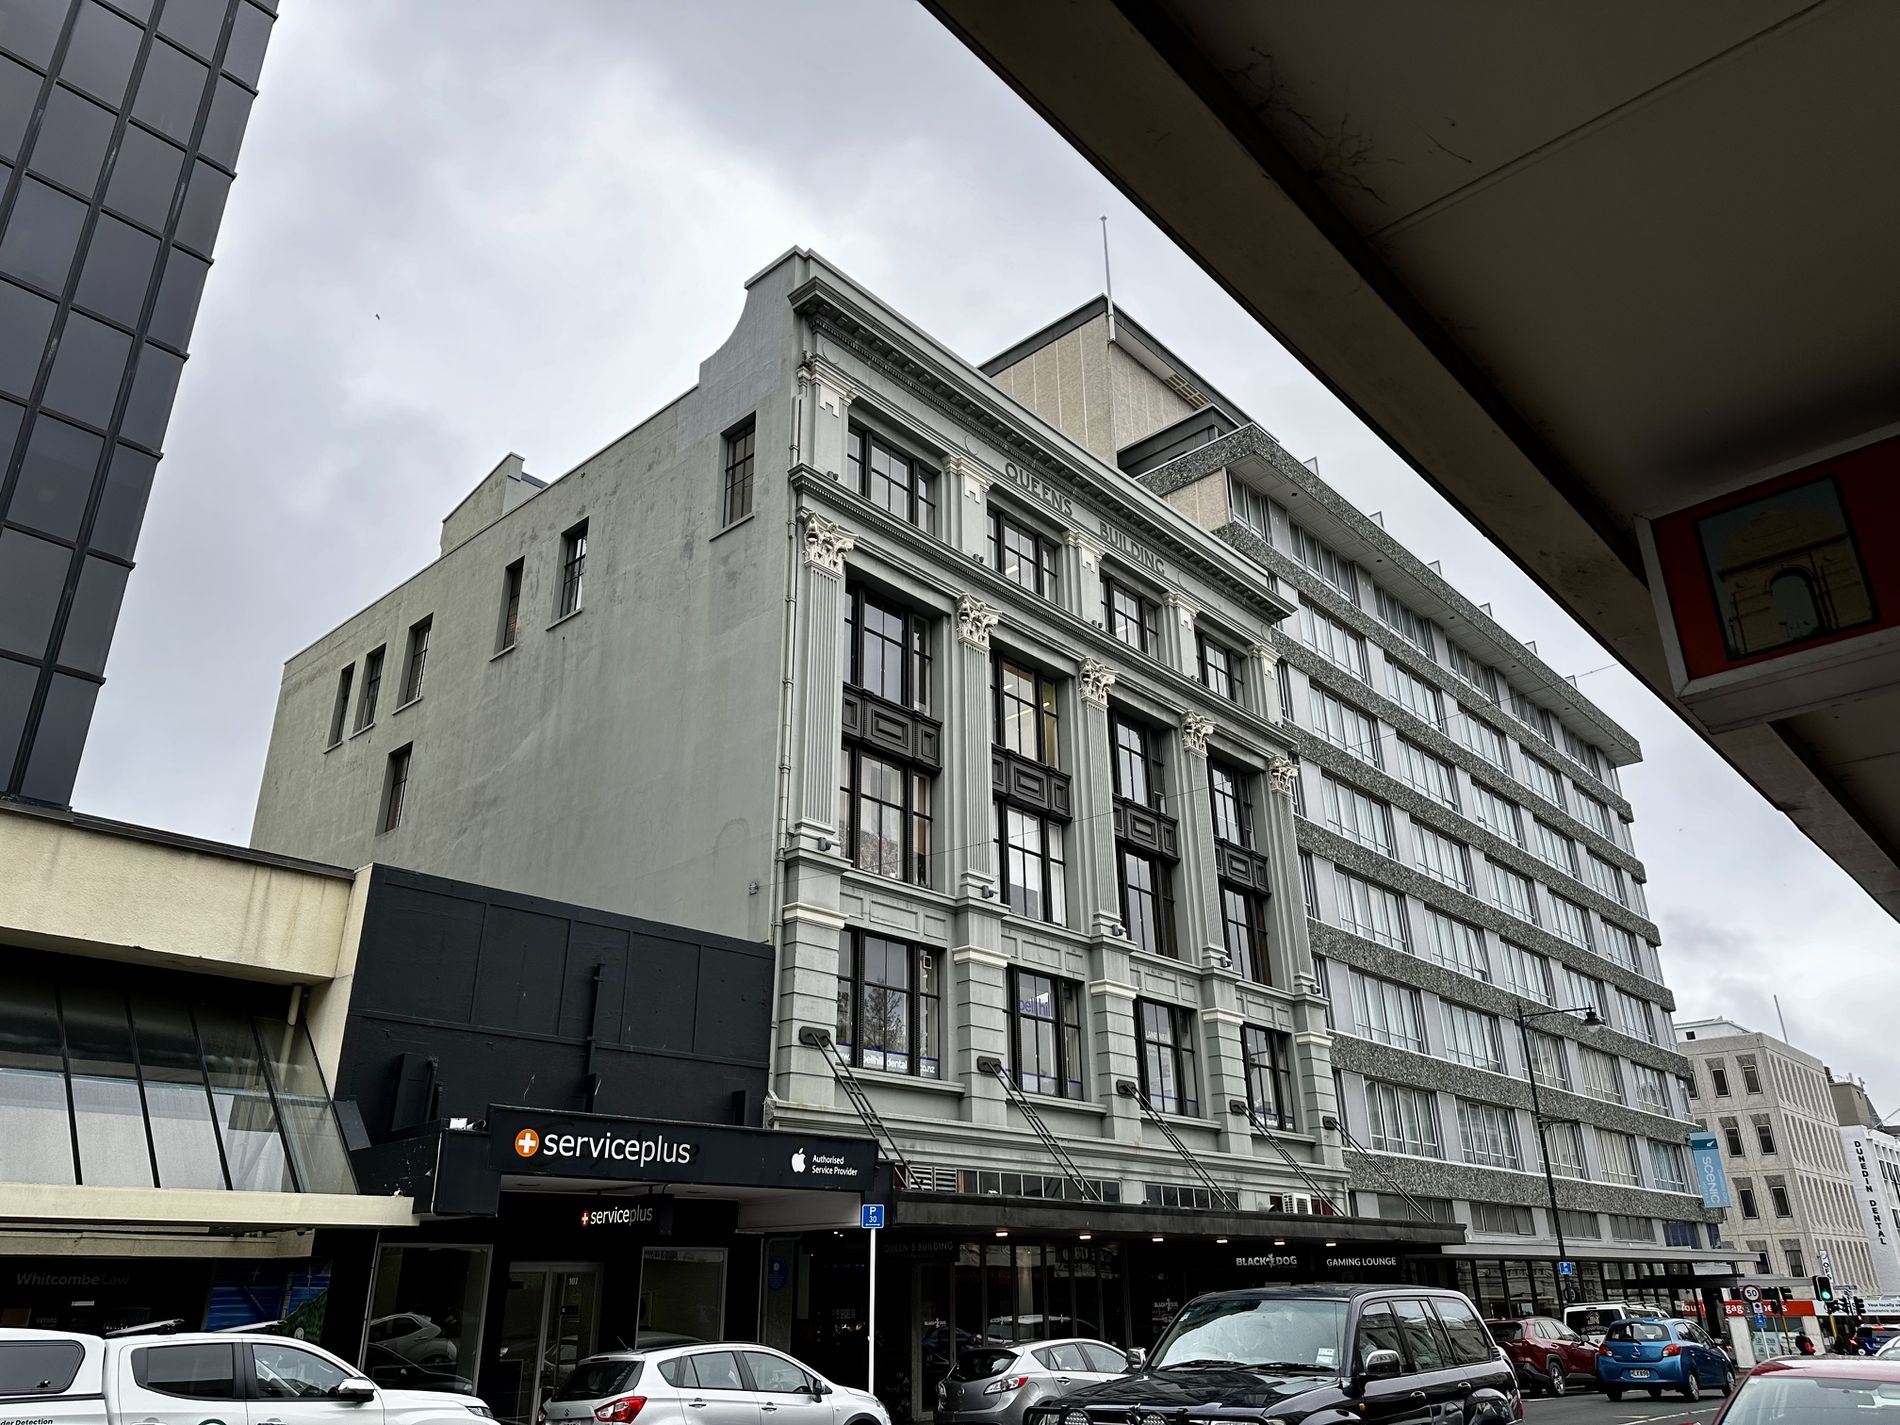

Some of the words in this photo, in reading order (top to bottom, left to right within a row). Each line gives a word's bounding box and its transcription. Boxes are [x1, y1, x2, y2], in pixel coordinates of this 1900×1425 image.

[1004, 461, 1073, 517] QUEEN'S
[1099, 520, 1165, 575] BUILDING
[542, 1131, 691, 1168] serviceplus
[812, 1154, 845, 1165] Authorised
[811, 1165, 833, 1175] Service
[833, 1166, 859, 1177] Provider
[1853, 1140, 1873, 1193] DUNEDIN
[1869, 1199, 1887, 1245] DENTAL
[590, 1204, 653, 1226] serviceplus
[869, 1206, 877, 1216] P
[868, 1215, 878, 1223] 30
[1235, 1256, 1267, 1267] BLACK
[1275, 1255, 1298, 1266] DOG
[1326, 1257, 1361, 1267] GAMING
[1362, 1256, 1397, 1266] LOUNGE
[16, 1271, 100, 1286] Whitcombe
[568, 1277, 579, 1286] 107
[1746, 1288, 1758, 1297] 50
